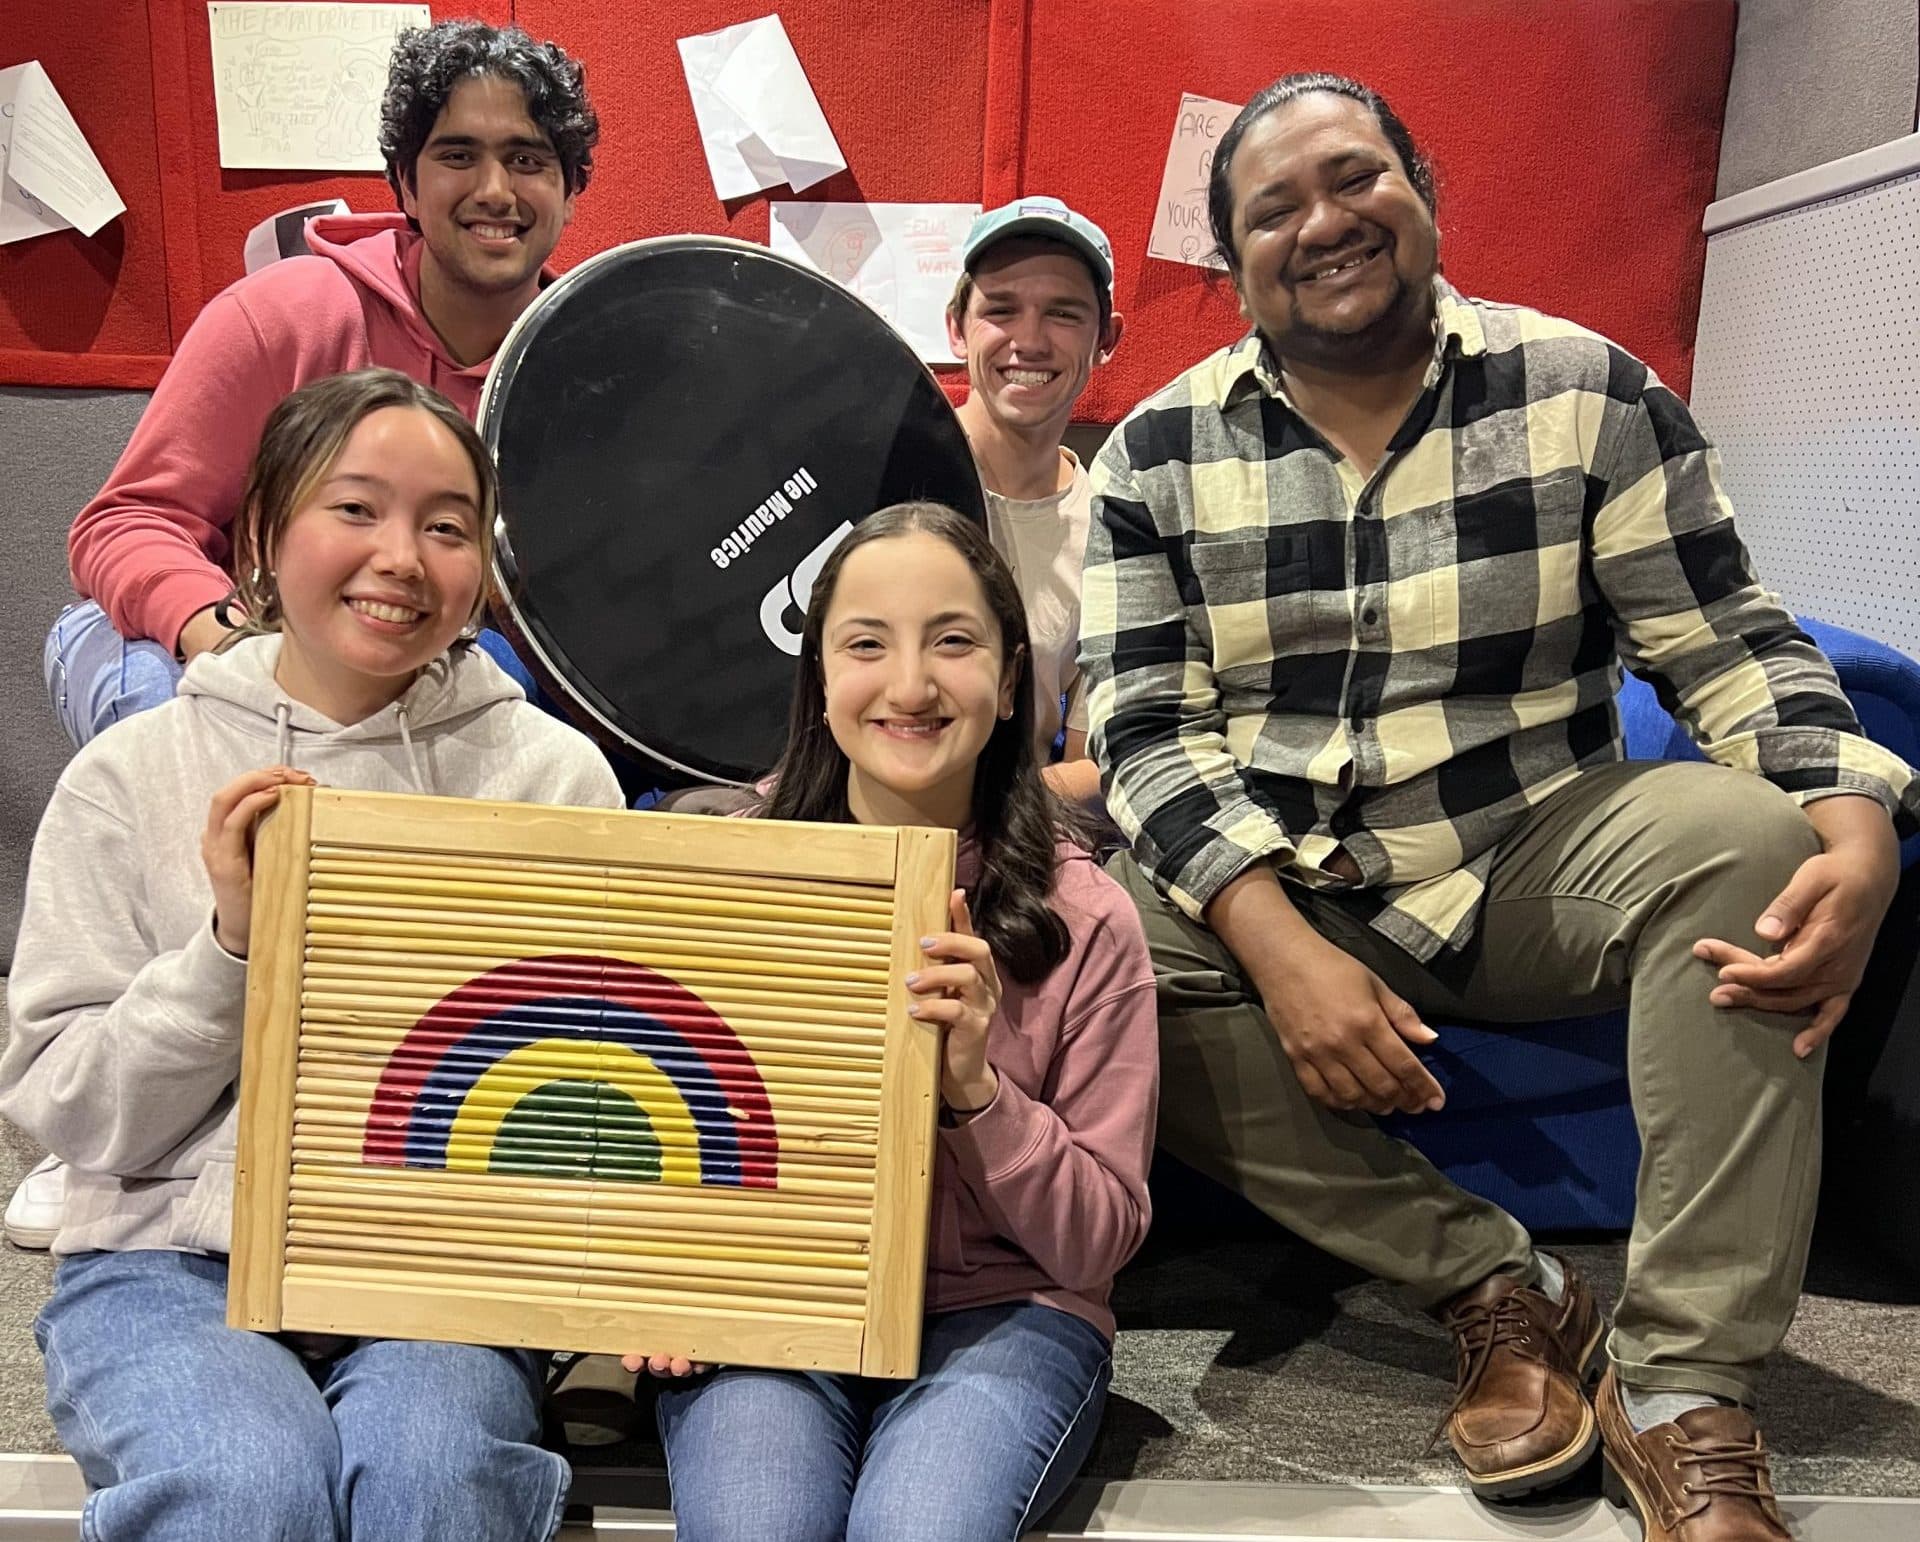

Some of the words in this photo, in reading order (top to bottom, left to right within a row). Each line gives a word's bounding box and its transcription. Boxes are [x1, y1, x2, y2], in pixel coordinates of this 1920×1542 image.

[218, 7, 257, 33] THE
[1178, 113, 1218, 138] ARE
[1168, 202, 1203, 229] YOUR
[710, 490, 793, 569] Maurice
